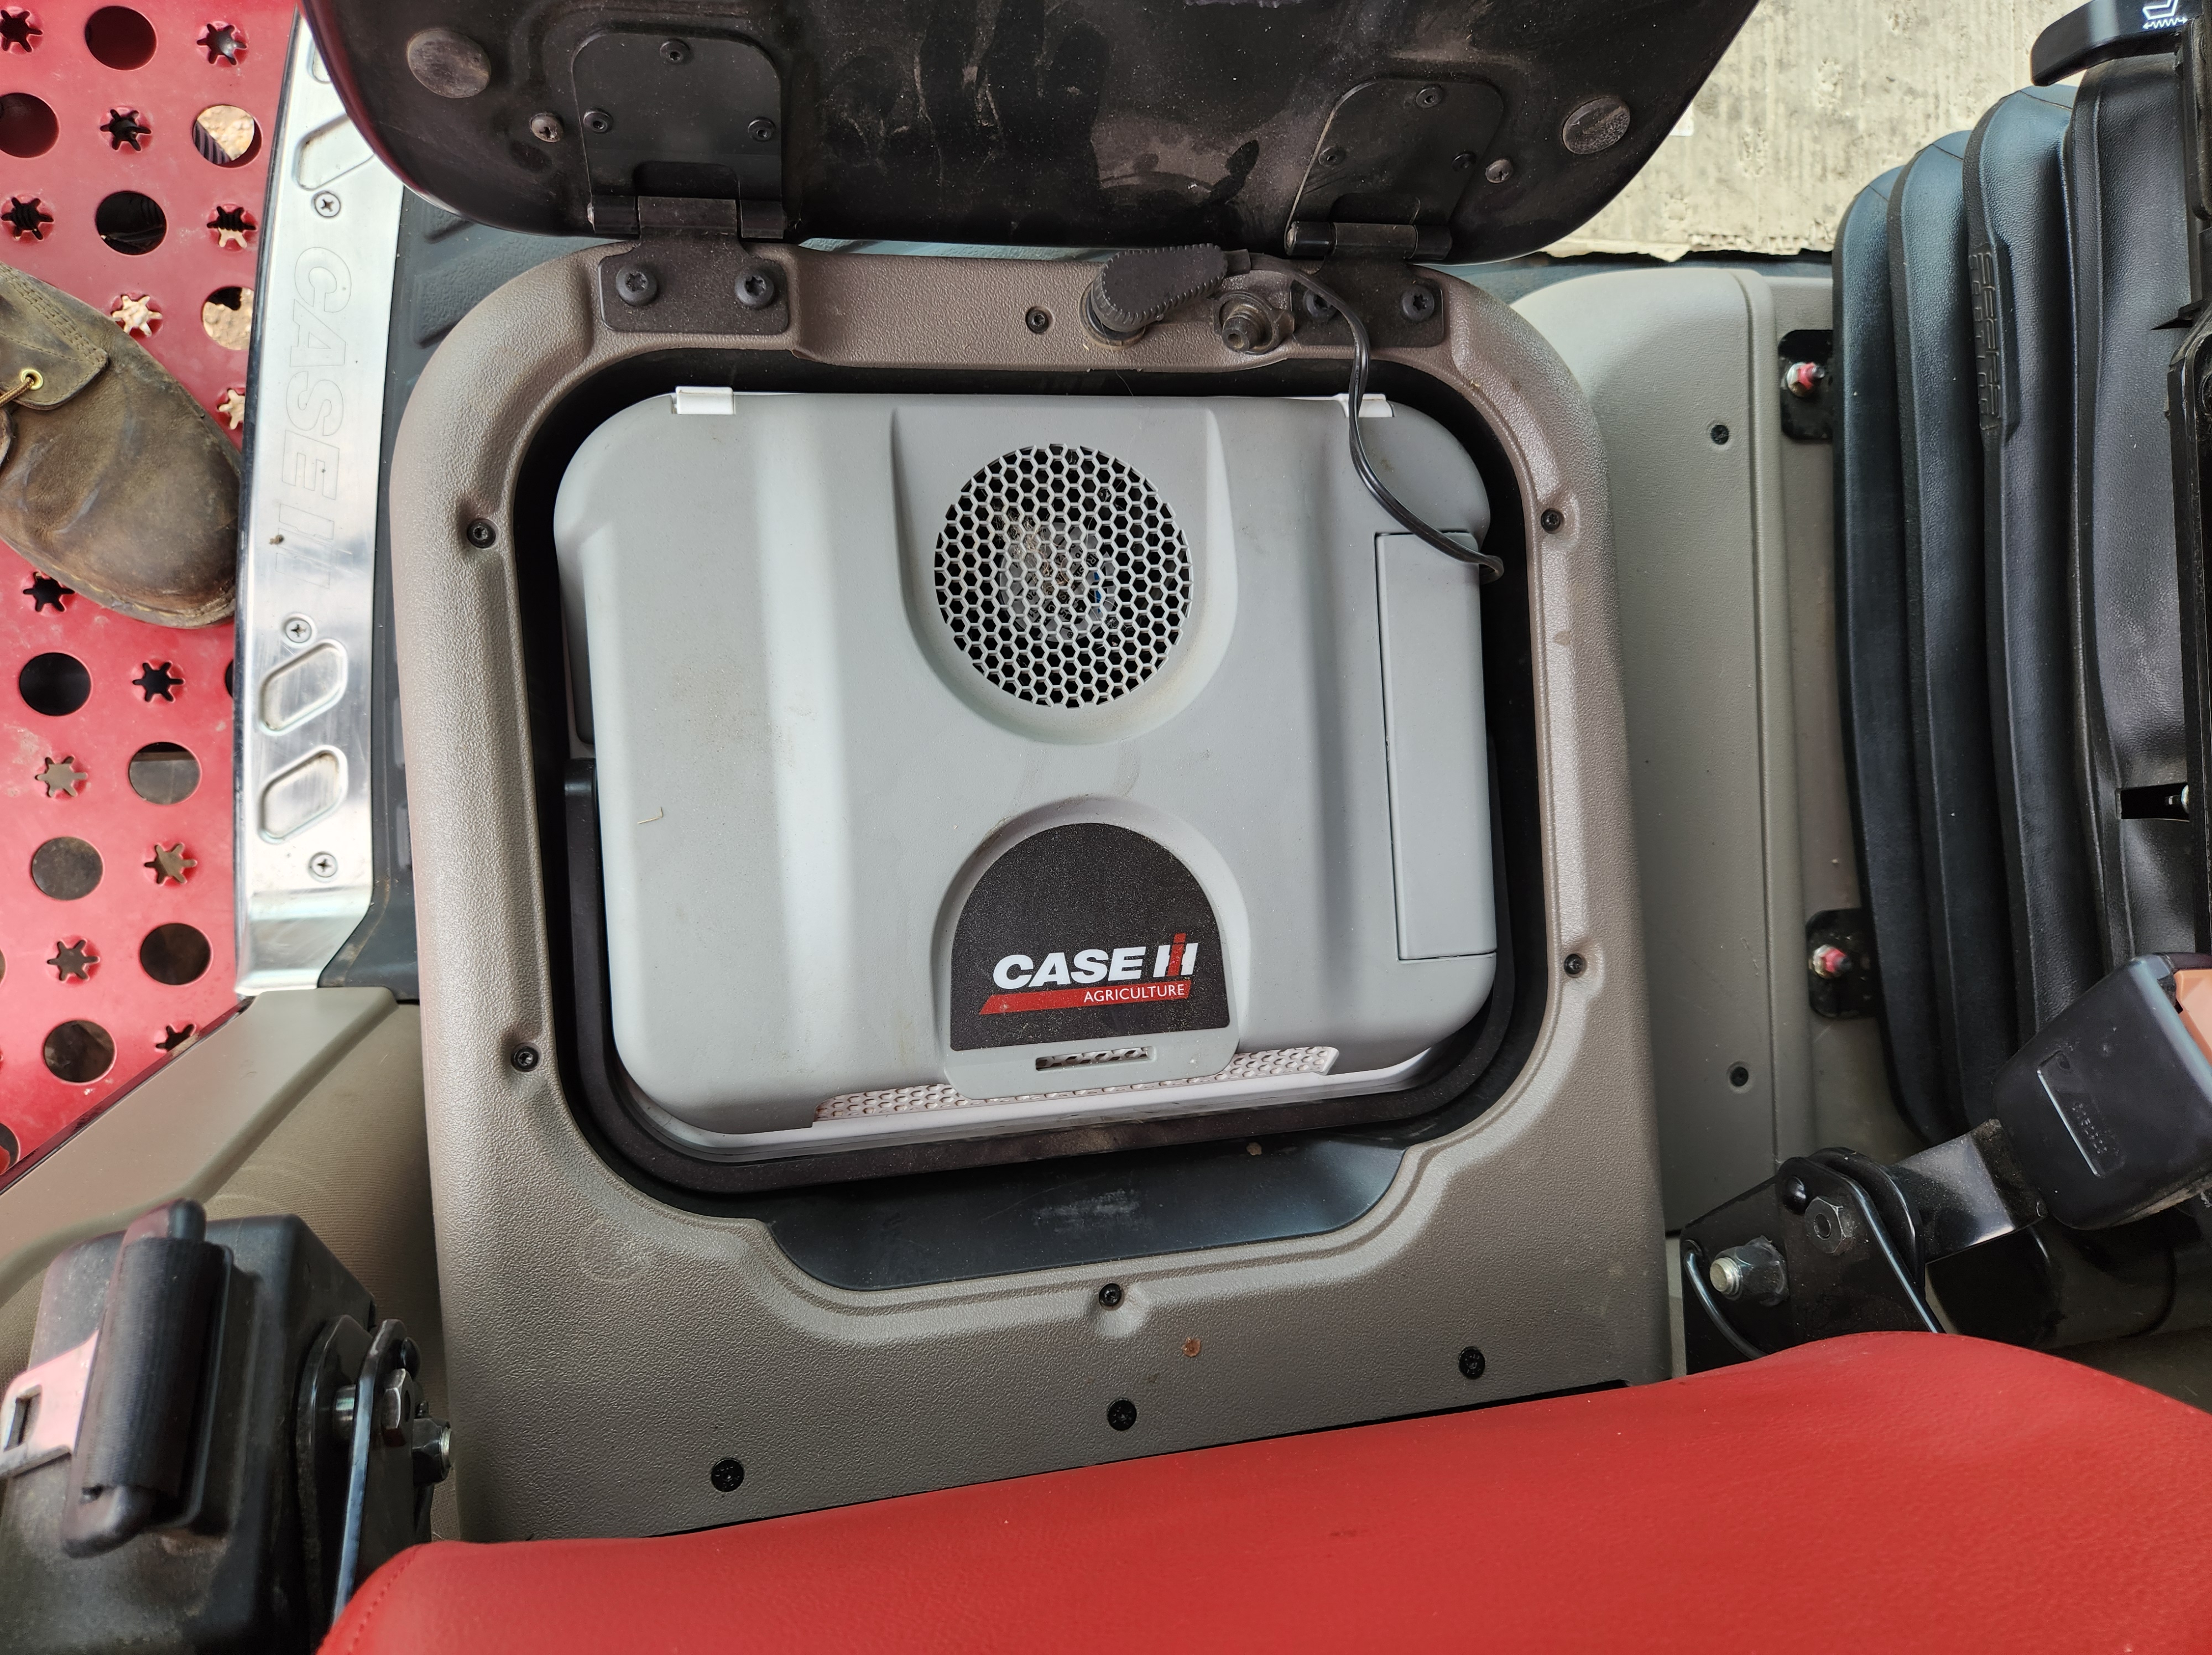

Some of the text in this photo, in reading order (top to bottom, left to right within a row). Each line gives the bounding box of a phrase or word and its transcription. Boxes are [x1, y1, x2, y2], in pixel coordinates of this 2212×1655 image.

[281, 246, 352, 500] CASE
[993, 933, 1199, 990] CASE IH
[1083, 983, 1185, 1003] AGRICULTURE
